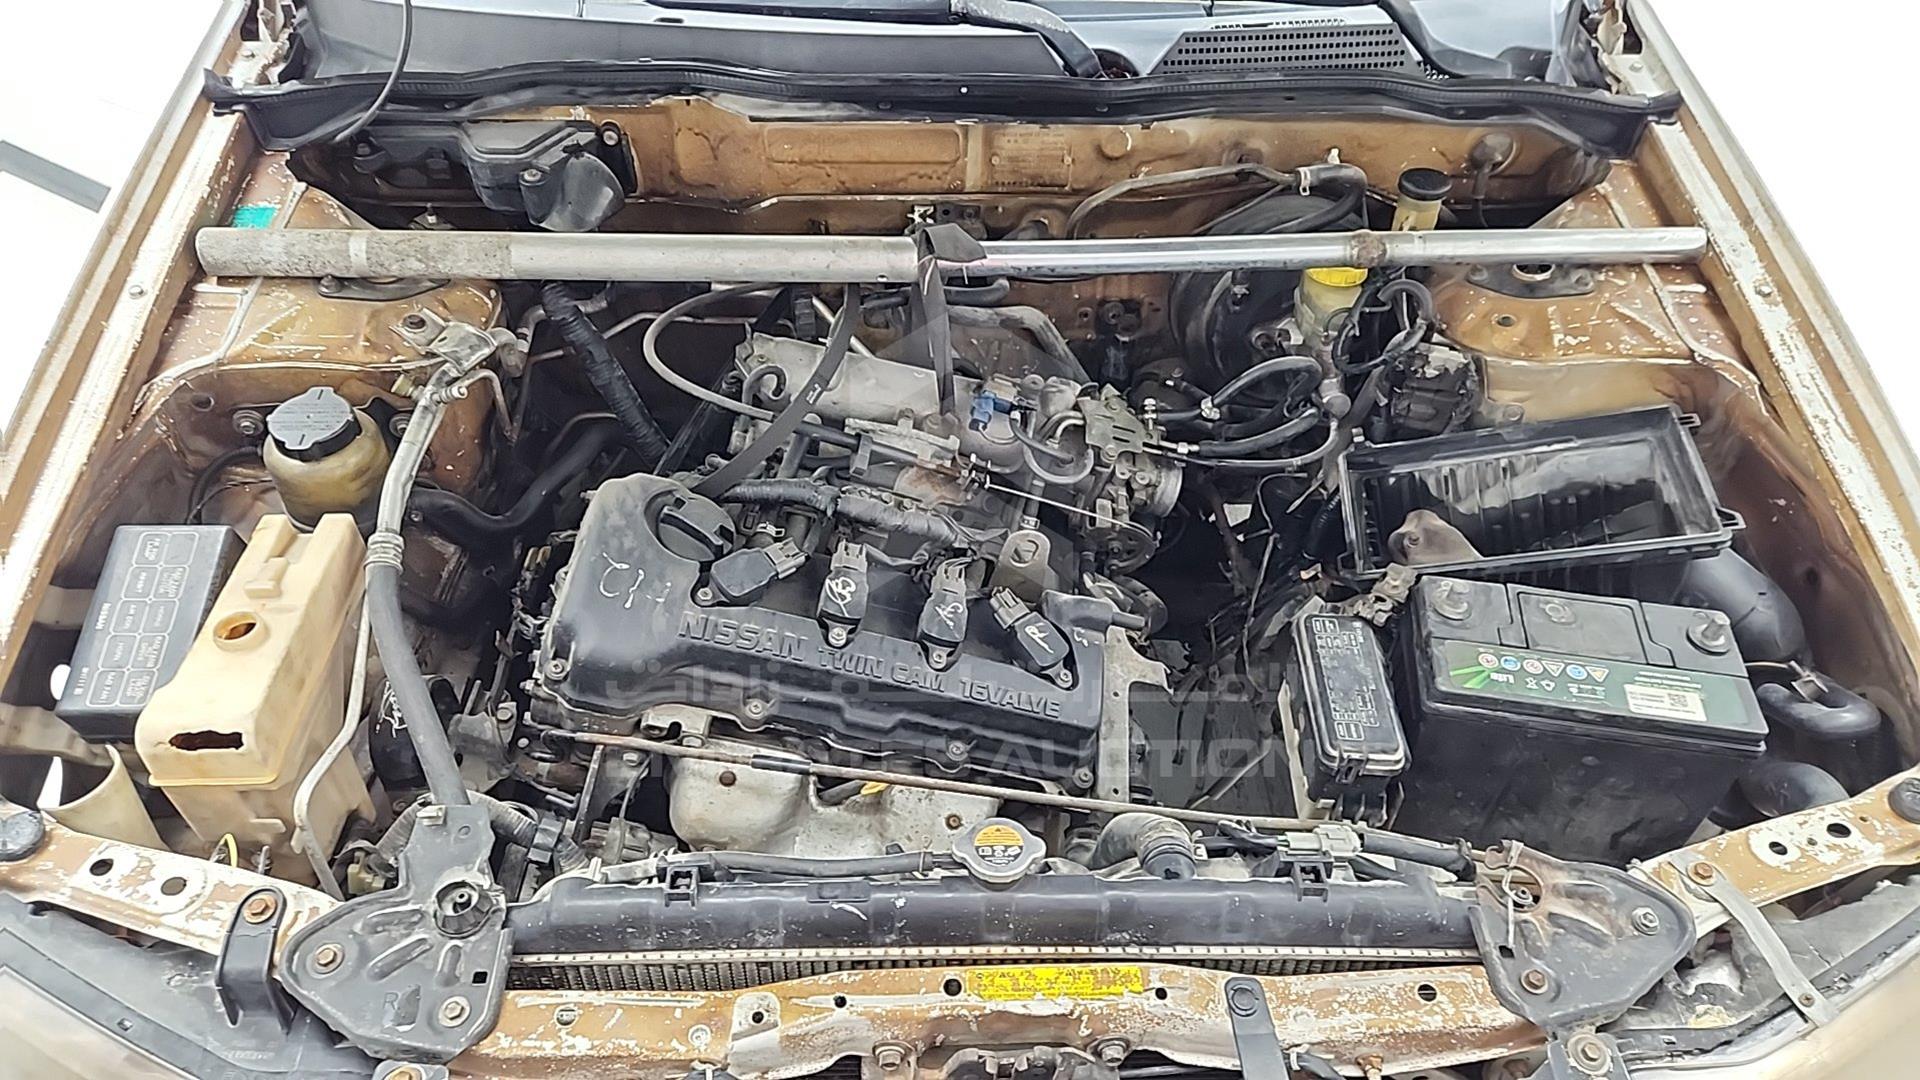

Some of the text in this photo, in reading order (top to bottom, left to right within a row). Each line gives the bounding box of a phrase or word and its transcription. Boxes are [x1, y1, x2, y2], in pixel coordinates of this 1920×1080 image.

[677, 610, 1061, 719] NISSAN TWIN CAM 16VALVE
